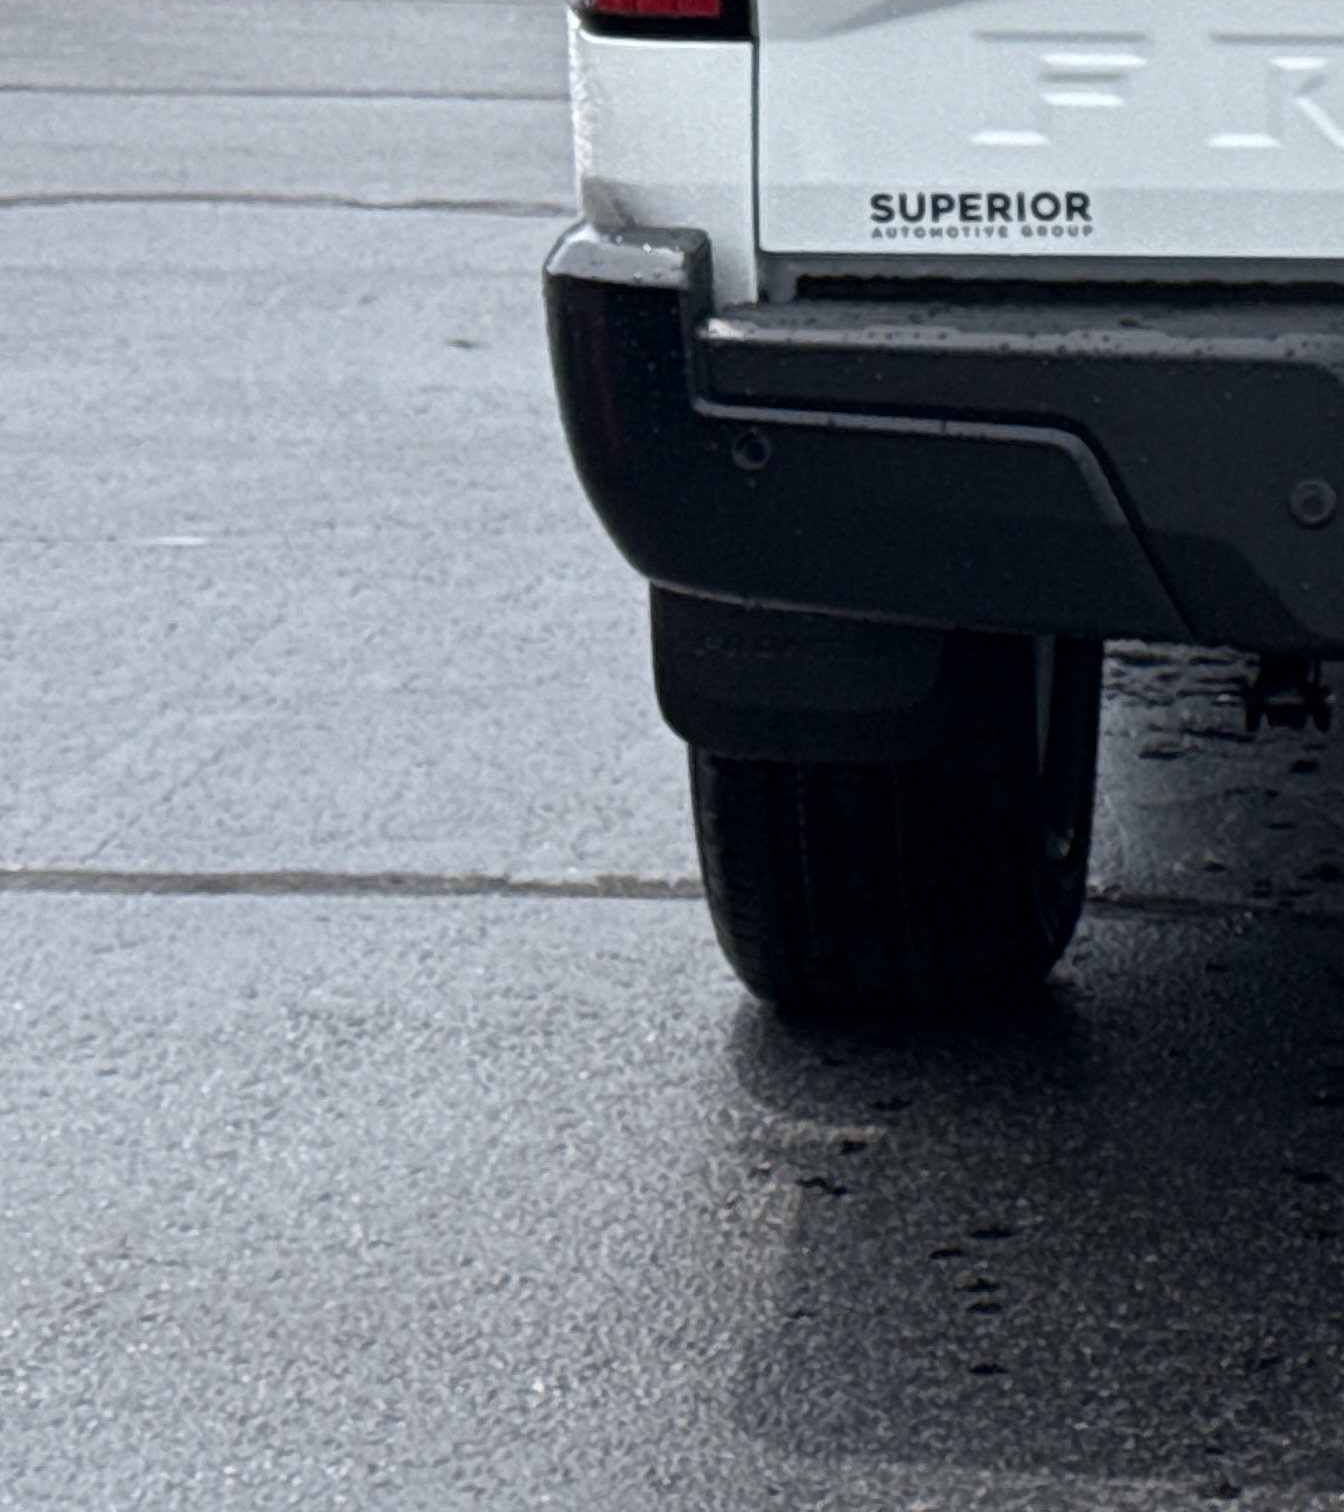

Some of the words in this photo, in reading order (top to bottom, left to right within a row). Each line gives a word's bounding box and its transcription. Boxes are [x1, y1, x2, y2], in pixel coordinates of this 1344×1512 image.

[869, 191, 1093, 224] SUPERIOR
[871, 225, 1009, 239] AUTOMOTIVE
[1020, 225, 1094, 239] GROUP
